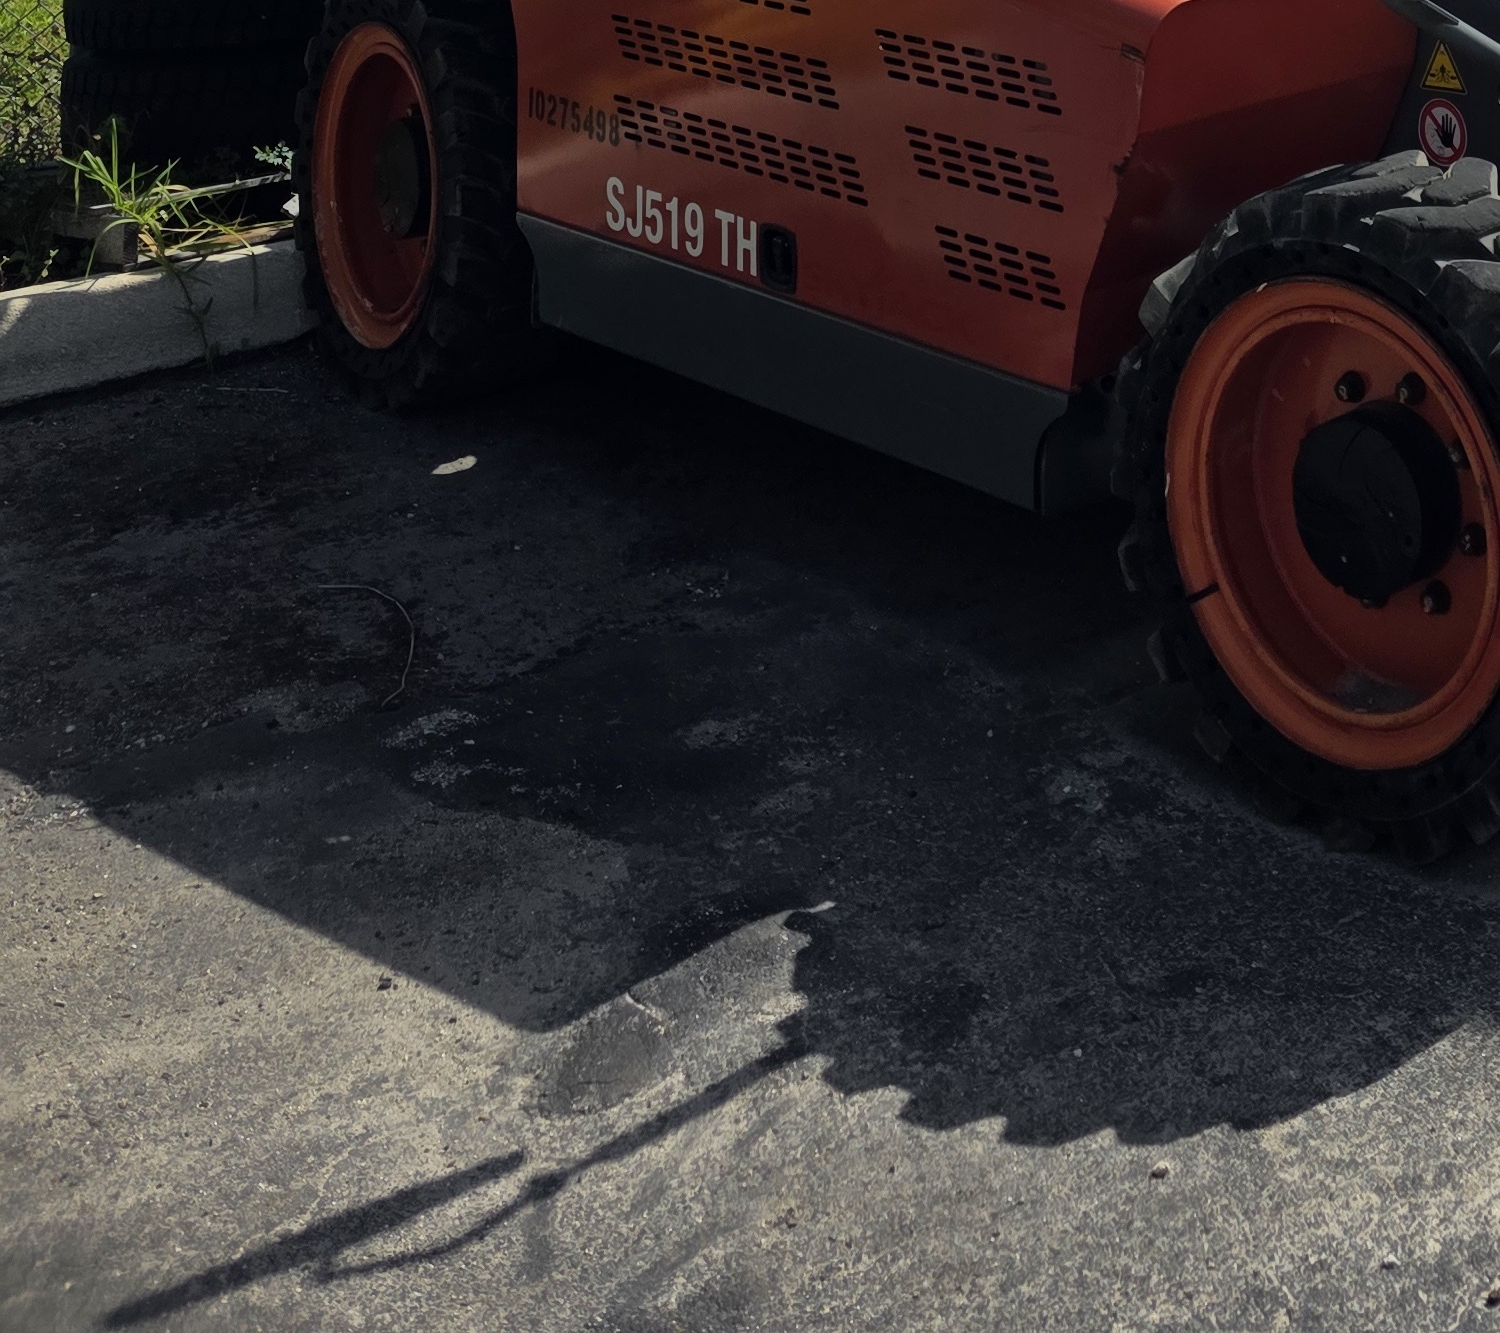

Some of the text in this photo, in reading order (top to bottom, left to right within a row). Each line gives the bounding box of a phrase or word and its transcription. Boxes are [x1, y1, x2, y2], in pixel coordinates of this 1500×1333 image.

[528, 86, 620, 148] 10275498
[605, 174, 759, 278] SJ519 TH
